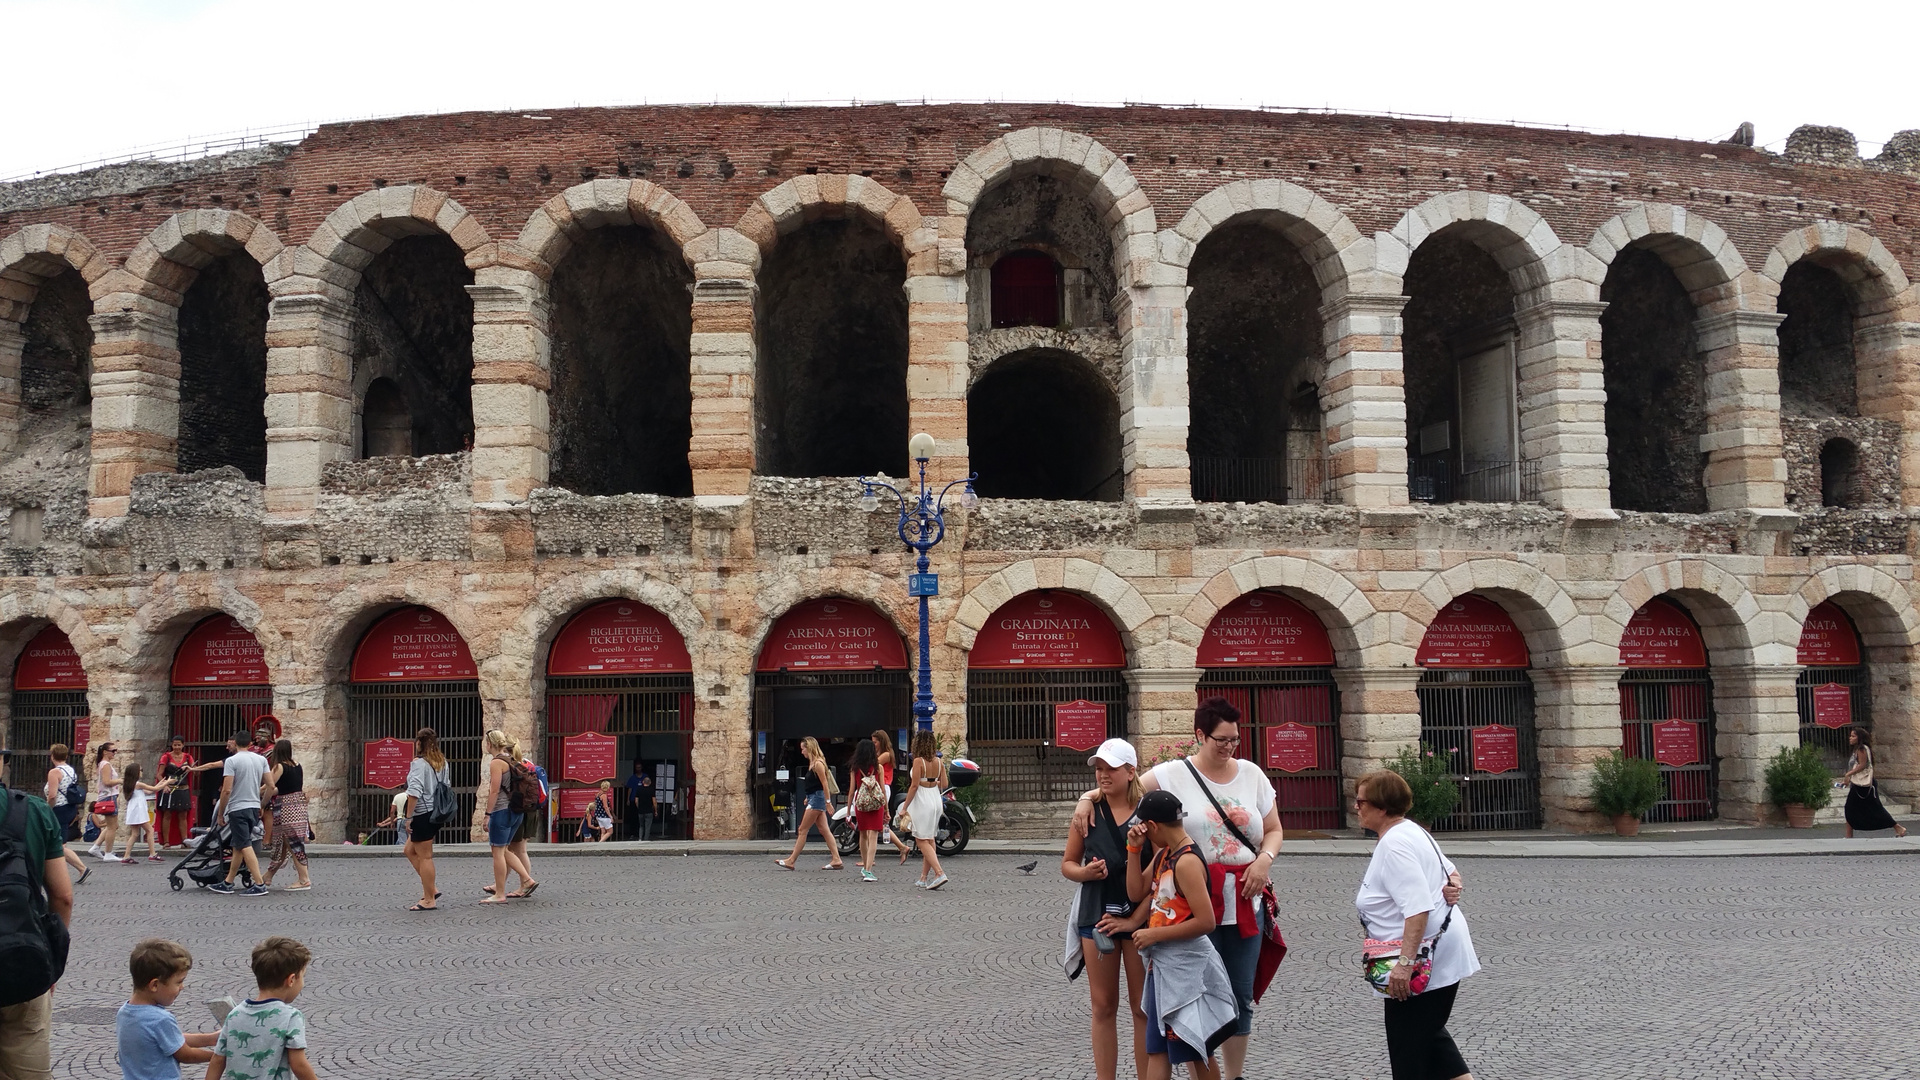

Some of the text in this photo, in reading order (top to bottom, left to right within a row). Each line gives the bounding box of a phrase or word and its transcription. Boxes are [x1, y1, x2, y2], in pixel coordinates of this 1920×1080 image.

[1001, 619, 1090, 629] GRADINATA
[1221, 617, 1292, 626] HOSPITALITY
[590, 626, 660, 635] BIGLIETTERIA
[787, 627, 875, 639] ARENA SHOP
[1212, 628, 1257, 636] STAMPA
[1271, 627, 1302, 635] PRESS
[1659, 627, 1690, 636] AREA
[393, 634, 457, 644] POLTRONE
[588, 635, 663, 644] TICKET OFFICE
[1017, 632, 1064, 640] SETTORE
[784, 642, 827, 650] Cancello
[839, 641, 862, 650] Gate
[866, 641, 878, 649] 10
[30, 649, 77, 657] GRADINATA
[205, 647, 264, 656] TICKET OFFIC
